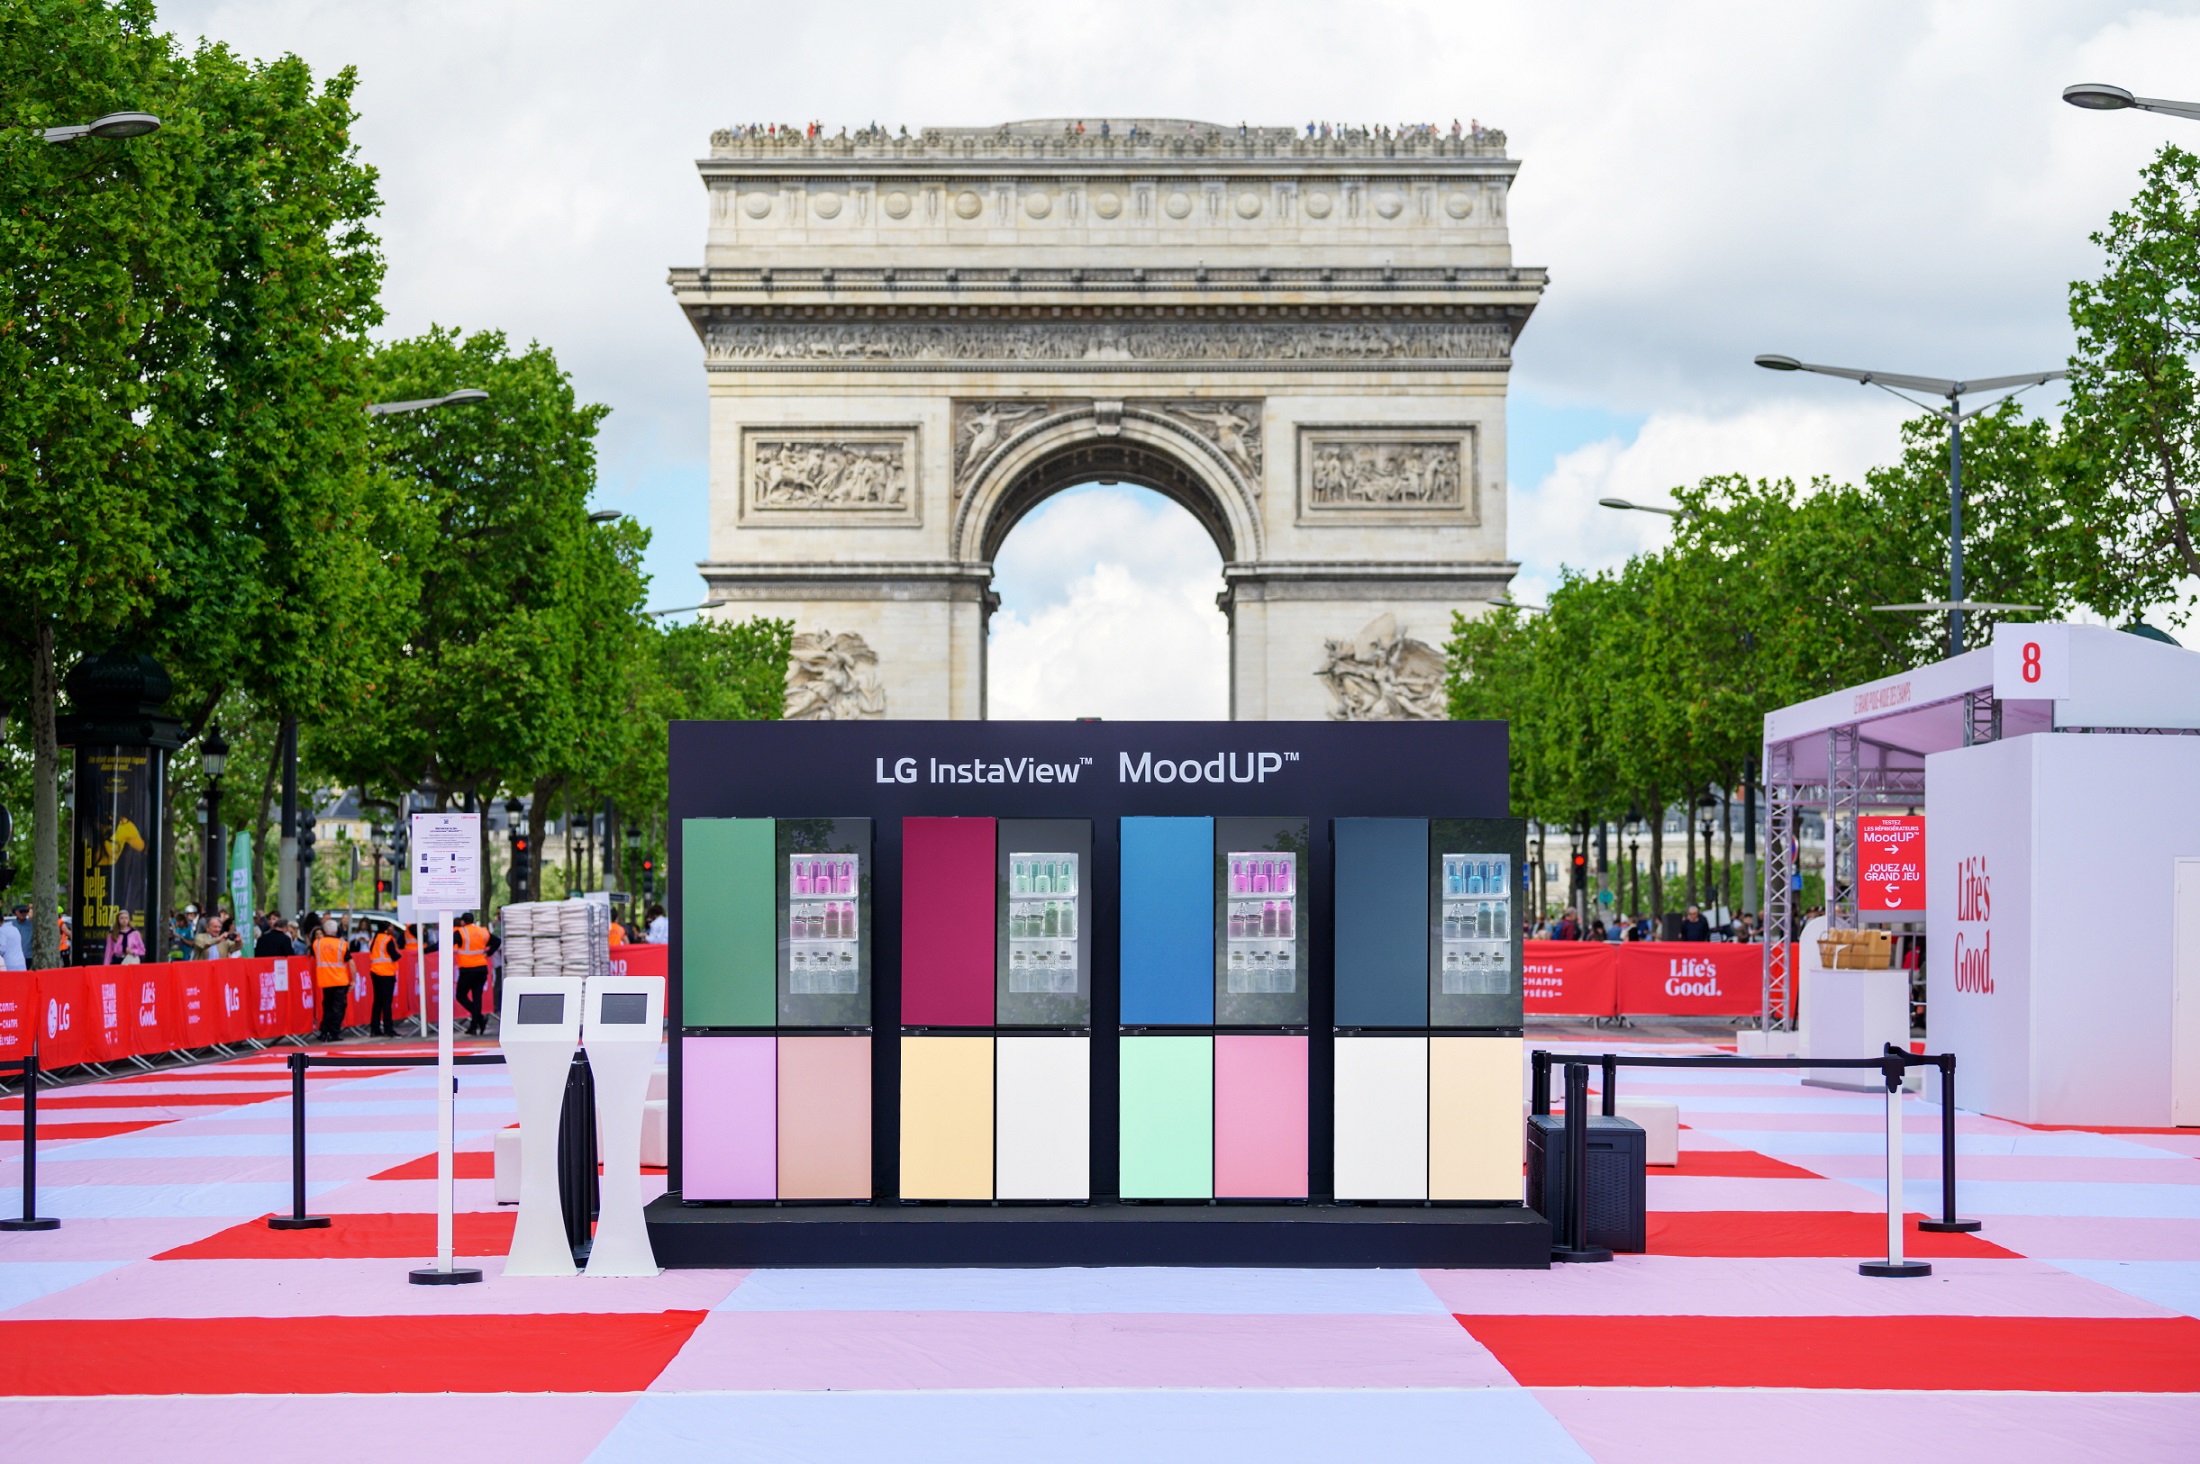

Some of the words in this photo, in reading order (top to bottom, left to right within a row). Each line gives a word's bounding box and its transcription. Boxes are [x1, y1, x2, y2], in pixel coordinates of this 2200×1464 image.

[2022, 642, 2041, 683] 8
[876, 757, 917, 784] LG
[930, 757, 1093, 784] InstaView™
[1119, 751, 1300, 784] MoodUP™
[1864, 872, 1900, 881] GRAND
[1902, 872, 1920, 881] JEU
[1868, 864, 1900, 872] JOUEZ
[1902, 864, 1916, 872] AU
[1958, 855, 1991, 922] Life's
[1669, 958, 1717, 978] Life's
[1954, 928, 1994, 995] Good.
[1664, 977, 1722, 996] Good.
[59, 1002, 70, 1030] LG
[140, 1004, 158, 1027] Good.
